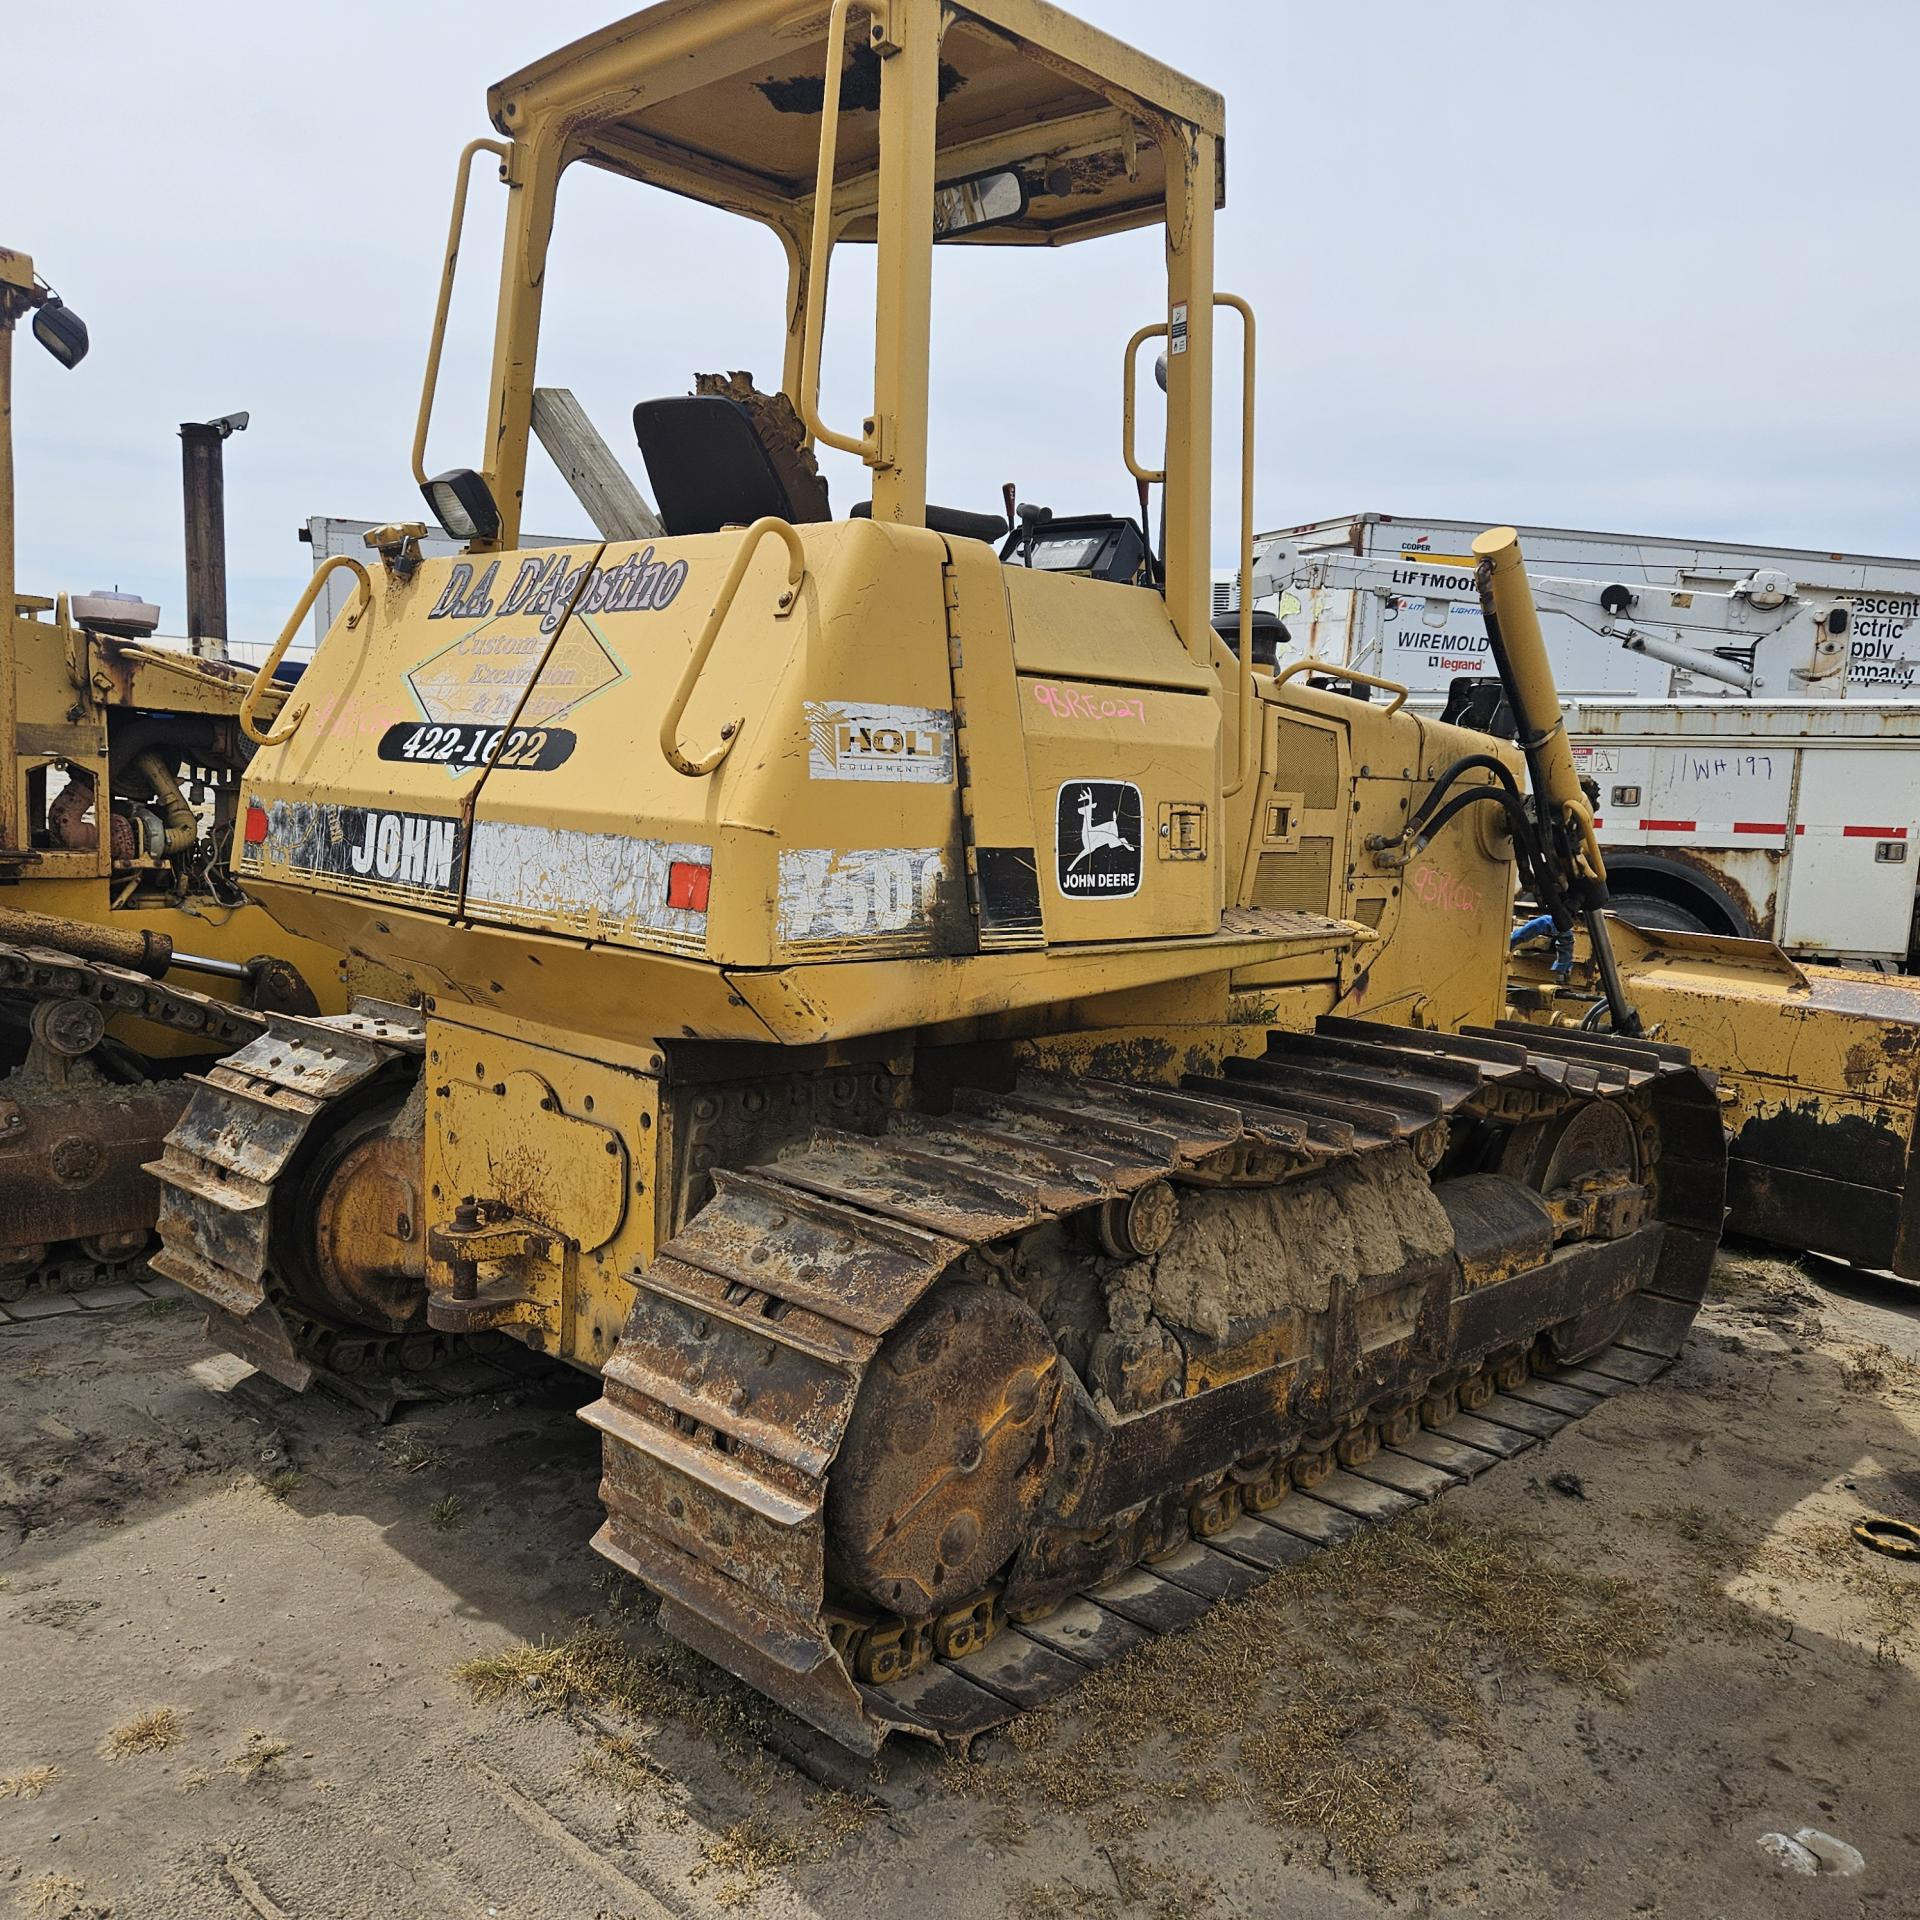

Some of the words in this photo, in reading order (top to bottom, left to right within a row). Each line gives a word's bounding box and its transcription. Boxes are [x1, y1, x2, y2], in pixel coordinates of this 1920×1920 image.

[1401, 542, 1431, 552] COOPER
[1398, 631, 1489, 653] WIREMOLD
[1440, 657, 1482, 672] legrand
[1034, 684, 1147, 726] 95RE027
[402, 726, 548, 767] 422-1622
[351, 812, 456, 888] JOHN
[1063, 874, 1096, 888] JOHN
[1098, 873, 1135, 887] DEERE
